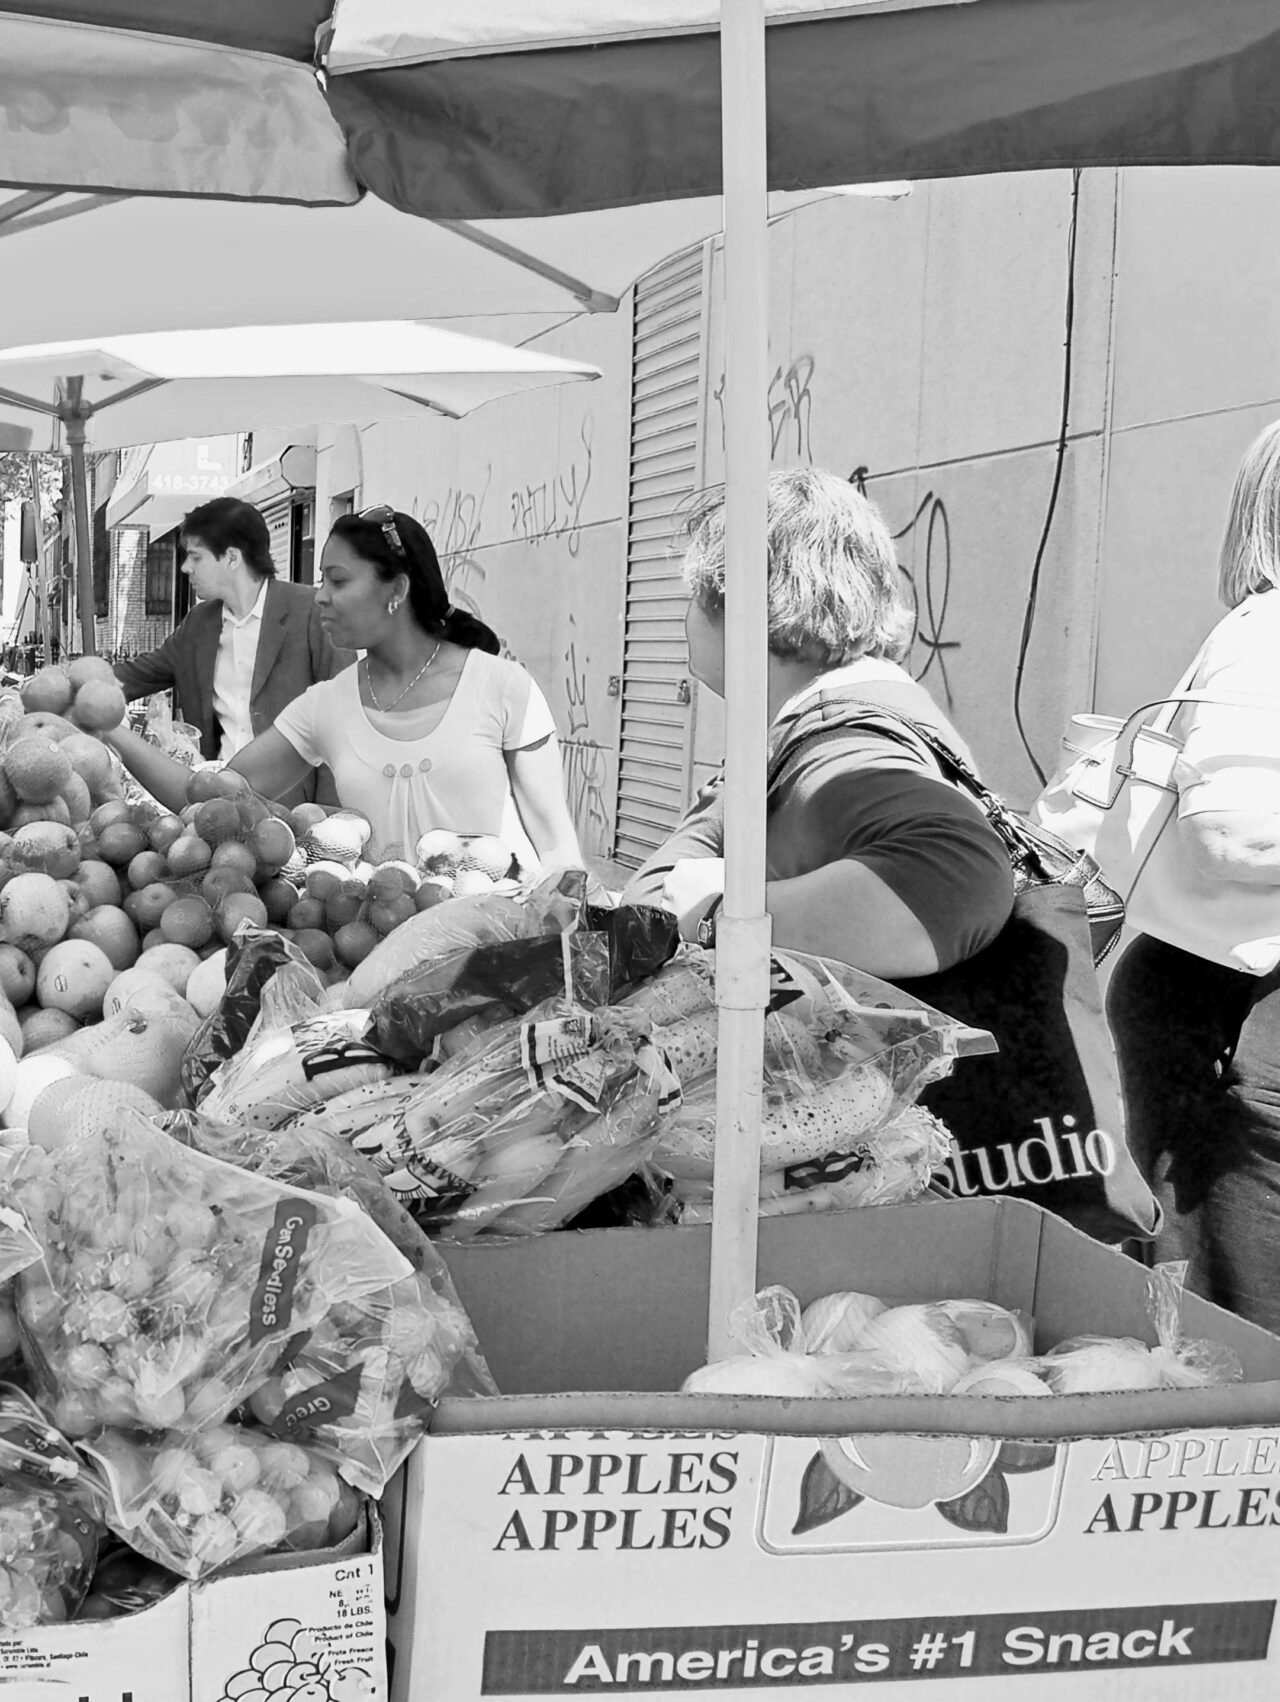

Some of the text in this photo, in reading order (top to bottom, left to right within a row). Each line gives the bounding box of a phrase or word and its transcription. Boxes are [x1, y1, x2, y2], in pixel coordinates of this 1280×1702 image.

[152, 474, 230, 491] 418-3743
[497, 1451, 740, 1496] APPLES
[1090, 1436, 1280, 1481] APPLE
[491, 1506, 733, 1551] APPLES
[336, 1609, 348, 1618] 18
[564, 1619, 1195, 1684] America's #1 Snack
